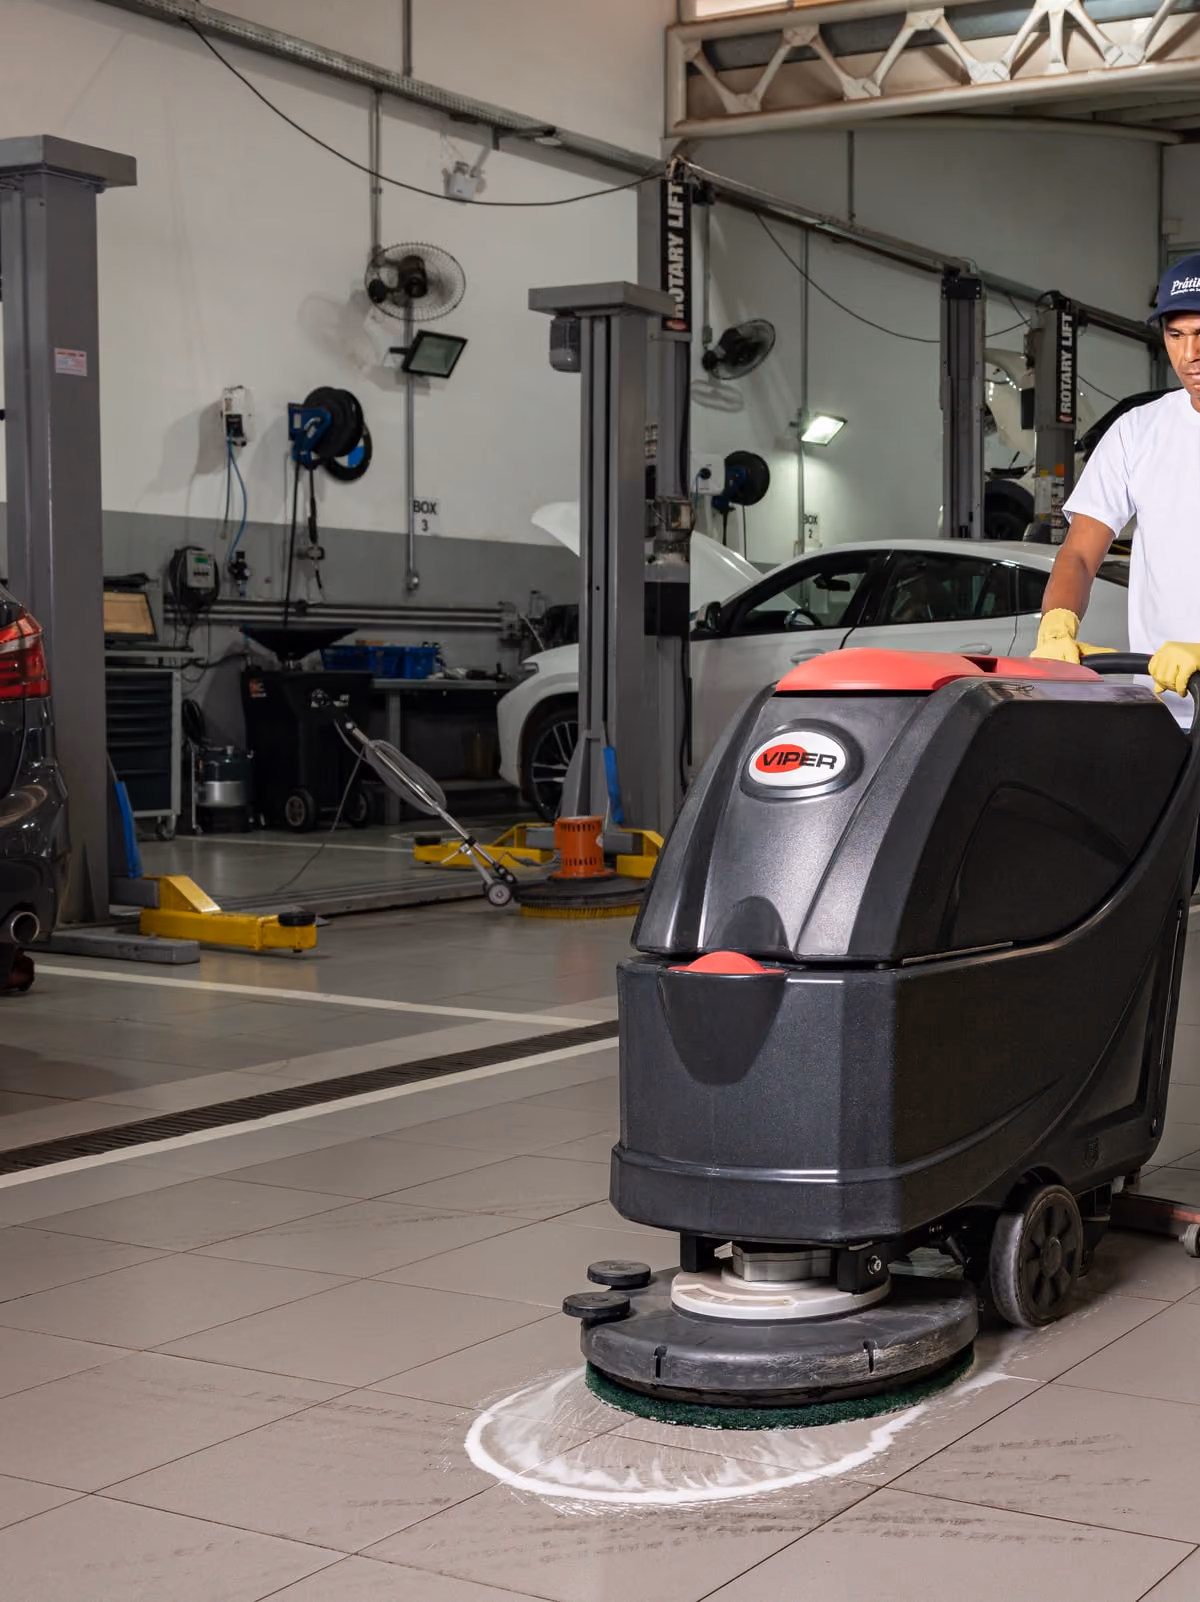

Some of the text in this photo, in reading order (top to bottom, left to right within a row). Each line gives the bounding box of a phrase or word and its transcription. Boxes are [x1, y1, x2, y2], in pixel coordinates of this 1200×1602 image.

[668, 182, 684, 228] LIFT
[1061, 312, 1073, 413] ROTARY LIFT
[413, 500, 438, 515] BOX
[421, 518, 429, 532] 3
[803, 514, 818, 525] BOX
[808, 528, 813, 539] 2
[763, 752, 837, 769] VIPER
